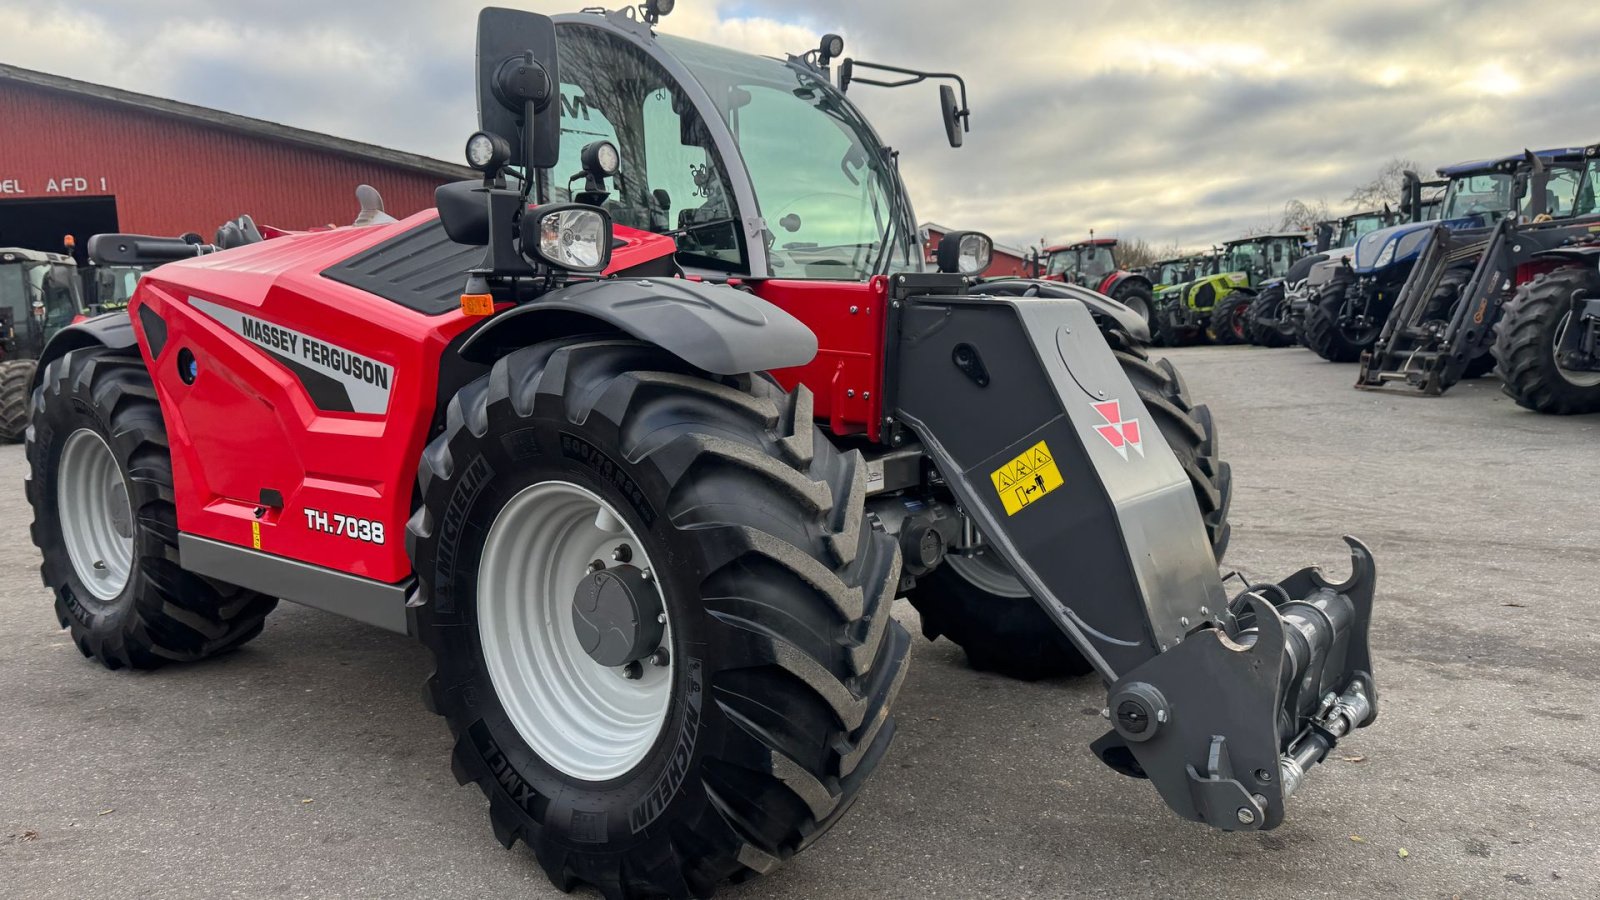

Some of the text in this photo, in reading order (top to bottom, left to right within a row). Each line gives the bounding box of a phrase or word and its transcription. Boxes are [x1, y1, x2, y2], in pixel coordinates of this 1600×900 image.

[0, 176, 107, 193] EL AFD 1
[242, 316, 388, 390] MASSEY FERGUSON
[303, 507, 385, 545] TH.7038
[437, 456, 491, 579] MICHELIN
[483, 739, 536, 811] XMCL
[631, 700, 700, 832] MICHELIN
